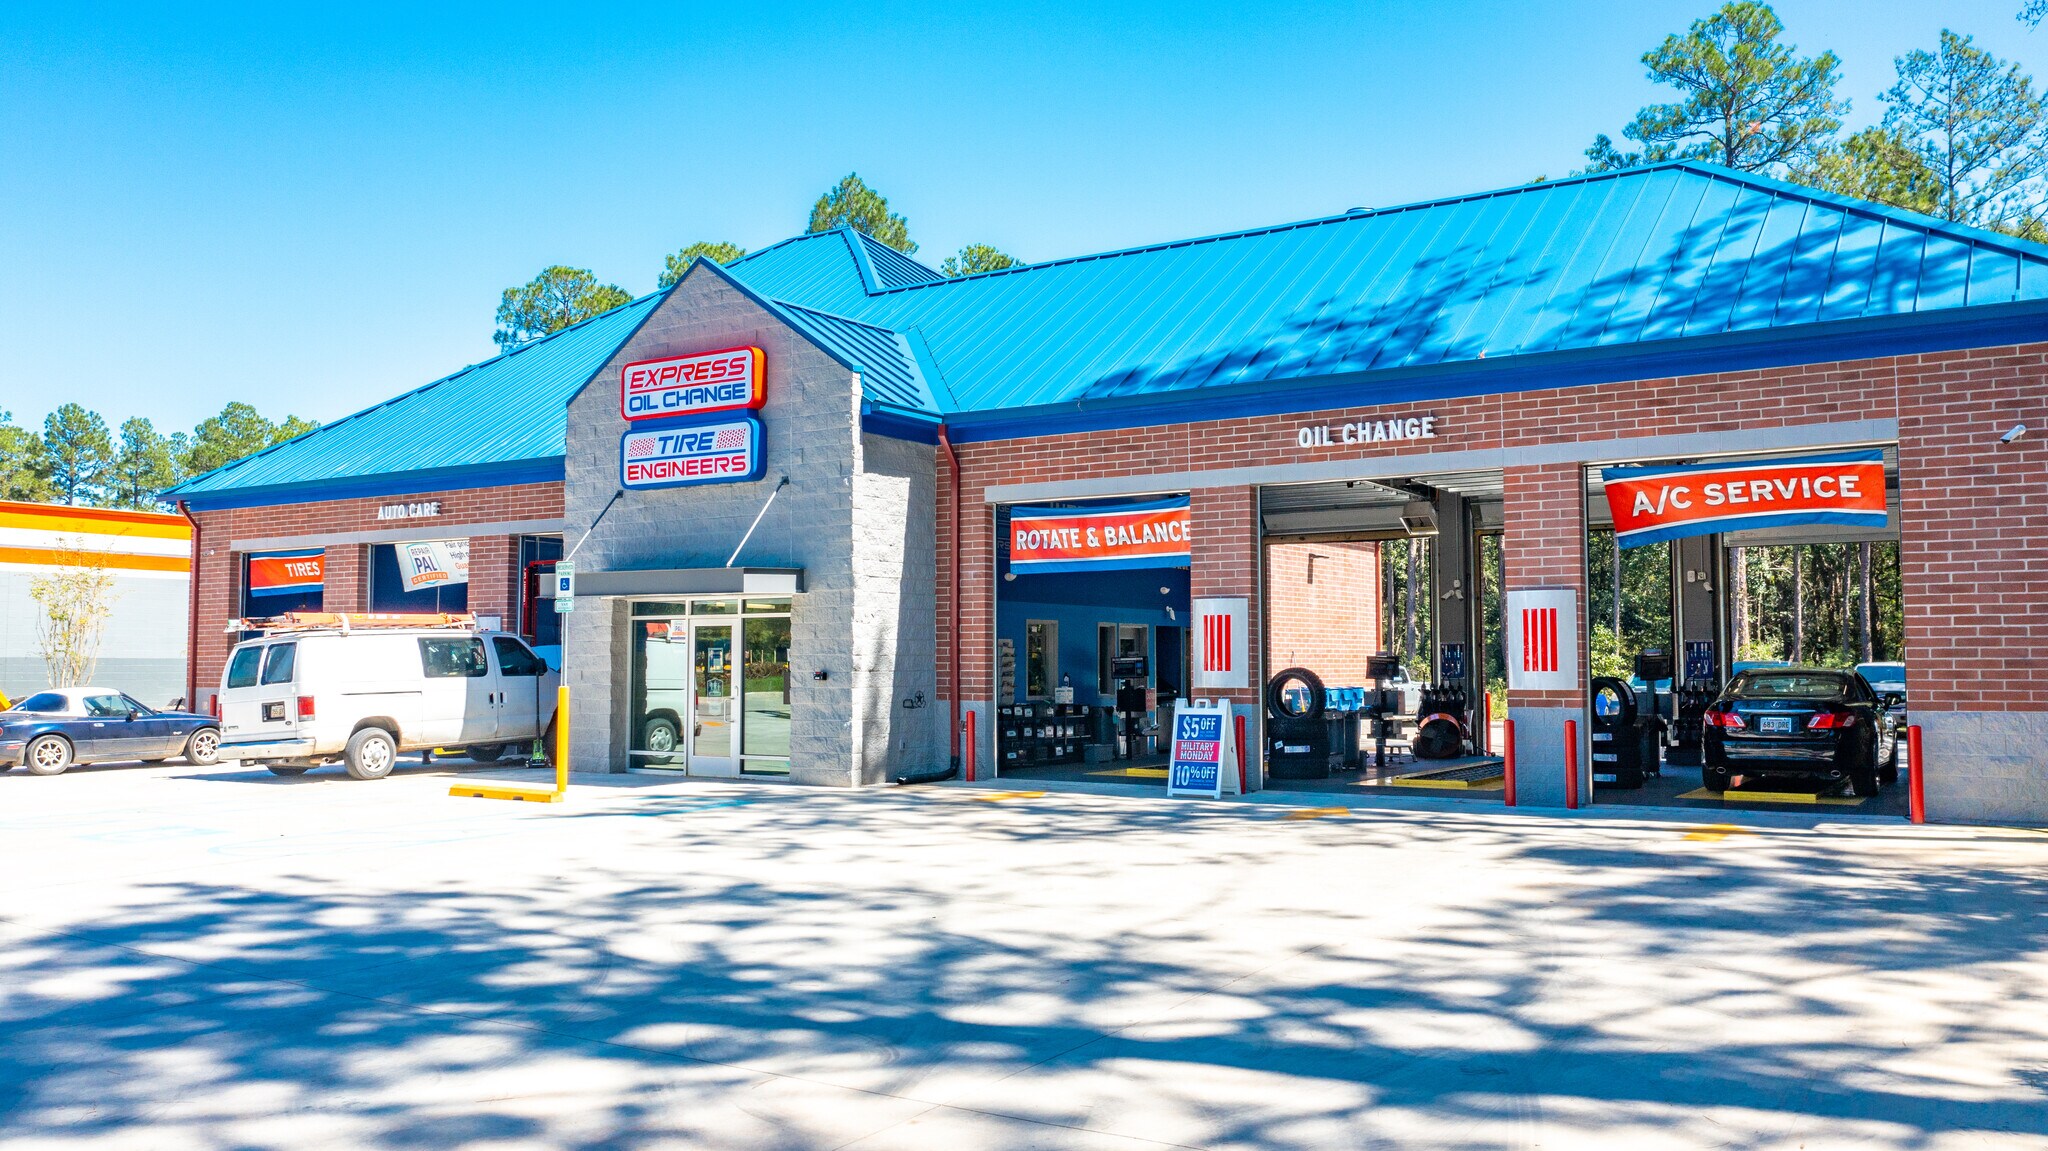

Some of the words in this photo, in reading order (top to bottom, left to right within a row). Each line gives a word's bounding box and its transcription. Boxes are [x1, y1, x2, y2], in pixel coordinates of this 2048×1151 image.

[629, 356, 747, 390] EXPRESS
[629, 394, 659, 412] OIL
[662, 382, 746, 408] CHANGE
[658, 431, 716, 455] TIRE
[1298, 425, 1335, 449] OIL
[1342, 416, 1436, 445] CHANGE
[627, 455, 746, 481] ENGINEERS
[1631, 484, 1693, 517] A/C
[1704, 475, 1862, 506] SERVICE
[378, 504, 406, 520] AUTO
[409, 501, 440, 518] CARE
[1015, 527, 1082, 551] ROTATE
[1086, 526, 1101, 548] &
[1104, 520, 1191, 547] BALANCE
[410, 546, 430, 556] REPAIR
[449, 551, 466, 560] High
[284, 561, 321, 578] TIRES
[414, 555, 438, 574] PAL
[413, 572, 447, 584] CERTIFIED
[1182, 715, 1199, 739] $5
[1200, 717, 1216, 730] OFF
[1180, 751, 1214, 760] MONDAY
[1181, 741, 1215, 751] MILITARY
